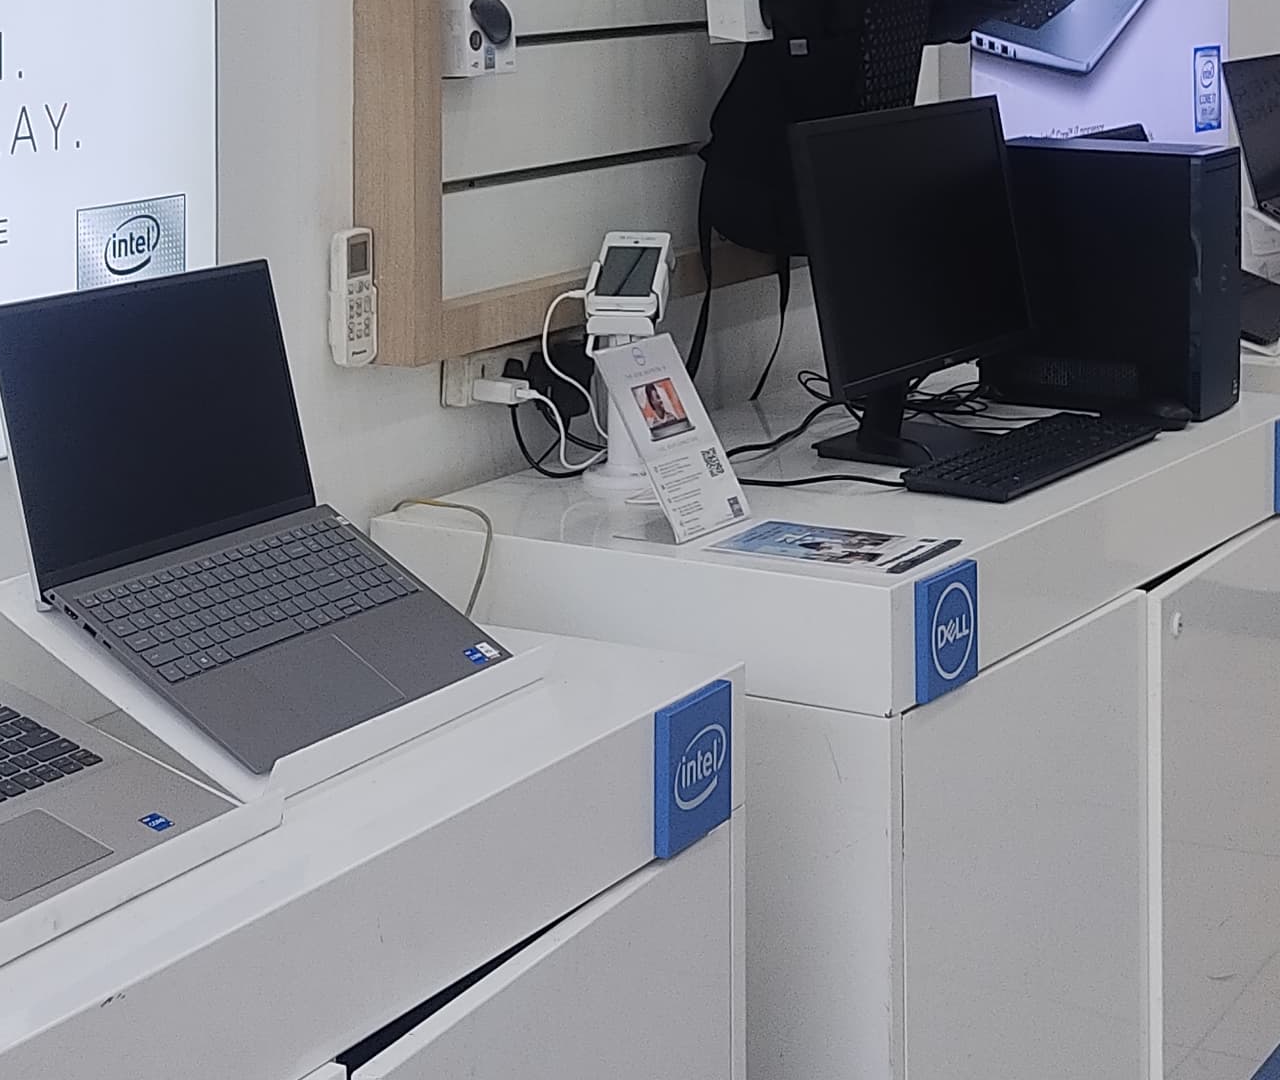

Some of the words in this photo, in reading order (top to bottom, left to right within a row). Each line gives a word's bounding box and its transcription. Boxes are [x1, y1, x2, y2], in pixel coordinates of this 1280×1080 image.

[113, 226, 154, 259] intel
[938, 614, 969, 648] DELL
[682, 737, 721, 789] intel
